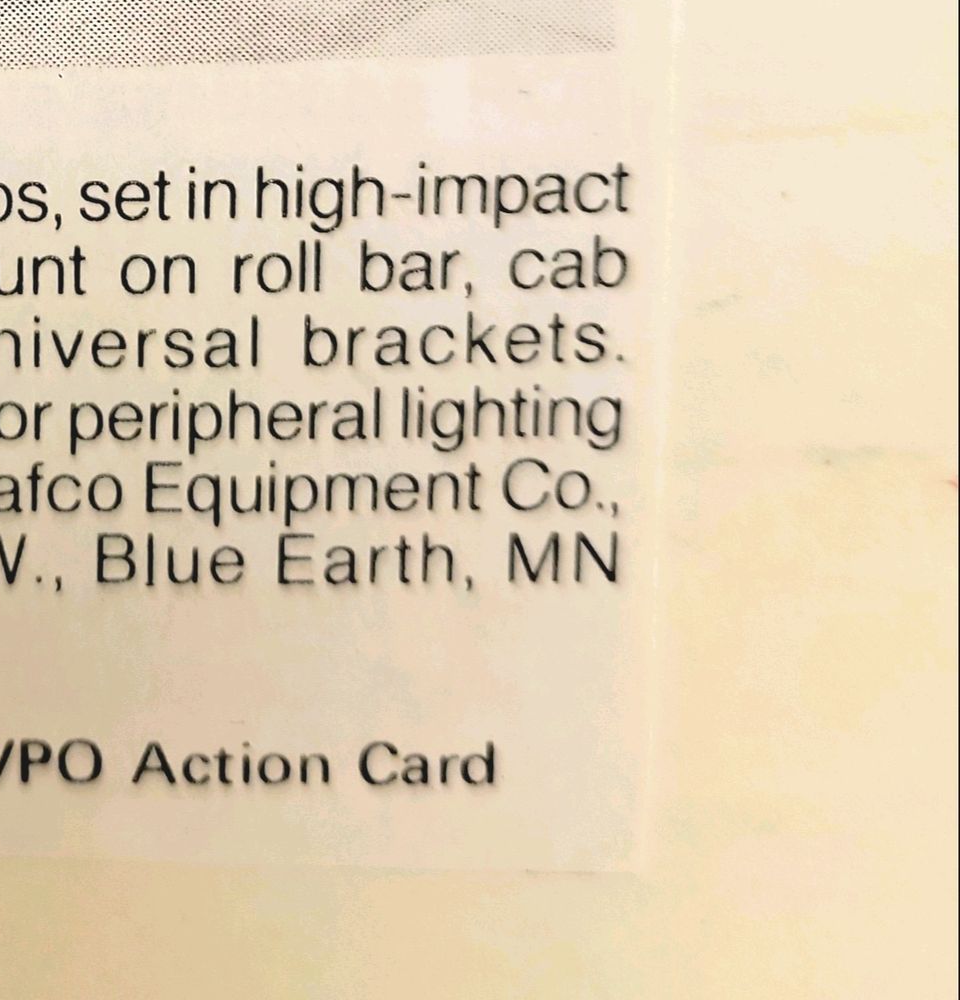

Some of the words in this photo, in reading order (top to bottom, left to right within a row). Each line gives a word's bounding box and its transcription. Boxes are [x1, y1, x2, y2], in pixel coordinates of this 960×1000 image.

[79, 169, 172, 223] set
[187, 165, 238, 221] in
[255, 160, 632, 235] high-impact
[119, 253, 197, 297] on
[233, 238, 323, 295] roll
[359, 238, 474, 299] bar,
[508, 234, 631, 291] cab
[303, 310, 625, 369] brackets.
[69, 386, 382, 458] peripheral
[401, 384, 625, 454] lighting
[145, 459, 483, 529] Equipment
[501, 457, 620, 519] Co.,
[96, 532, 246, 589] Blue
[277, 532, 474, 593] Earth,
[507, 530, 620, 585] MN
[131, 741, 331, 789] Action
[357, 740, 498, 789] Card
